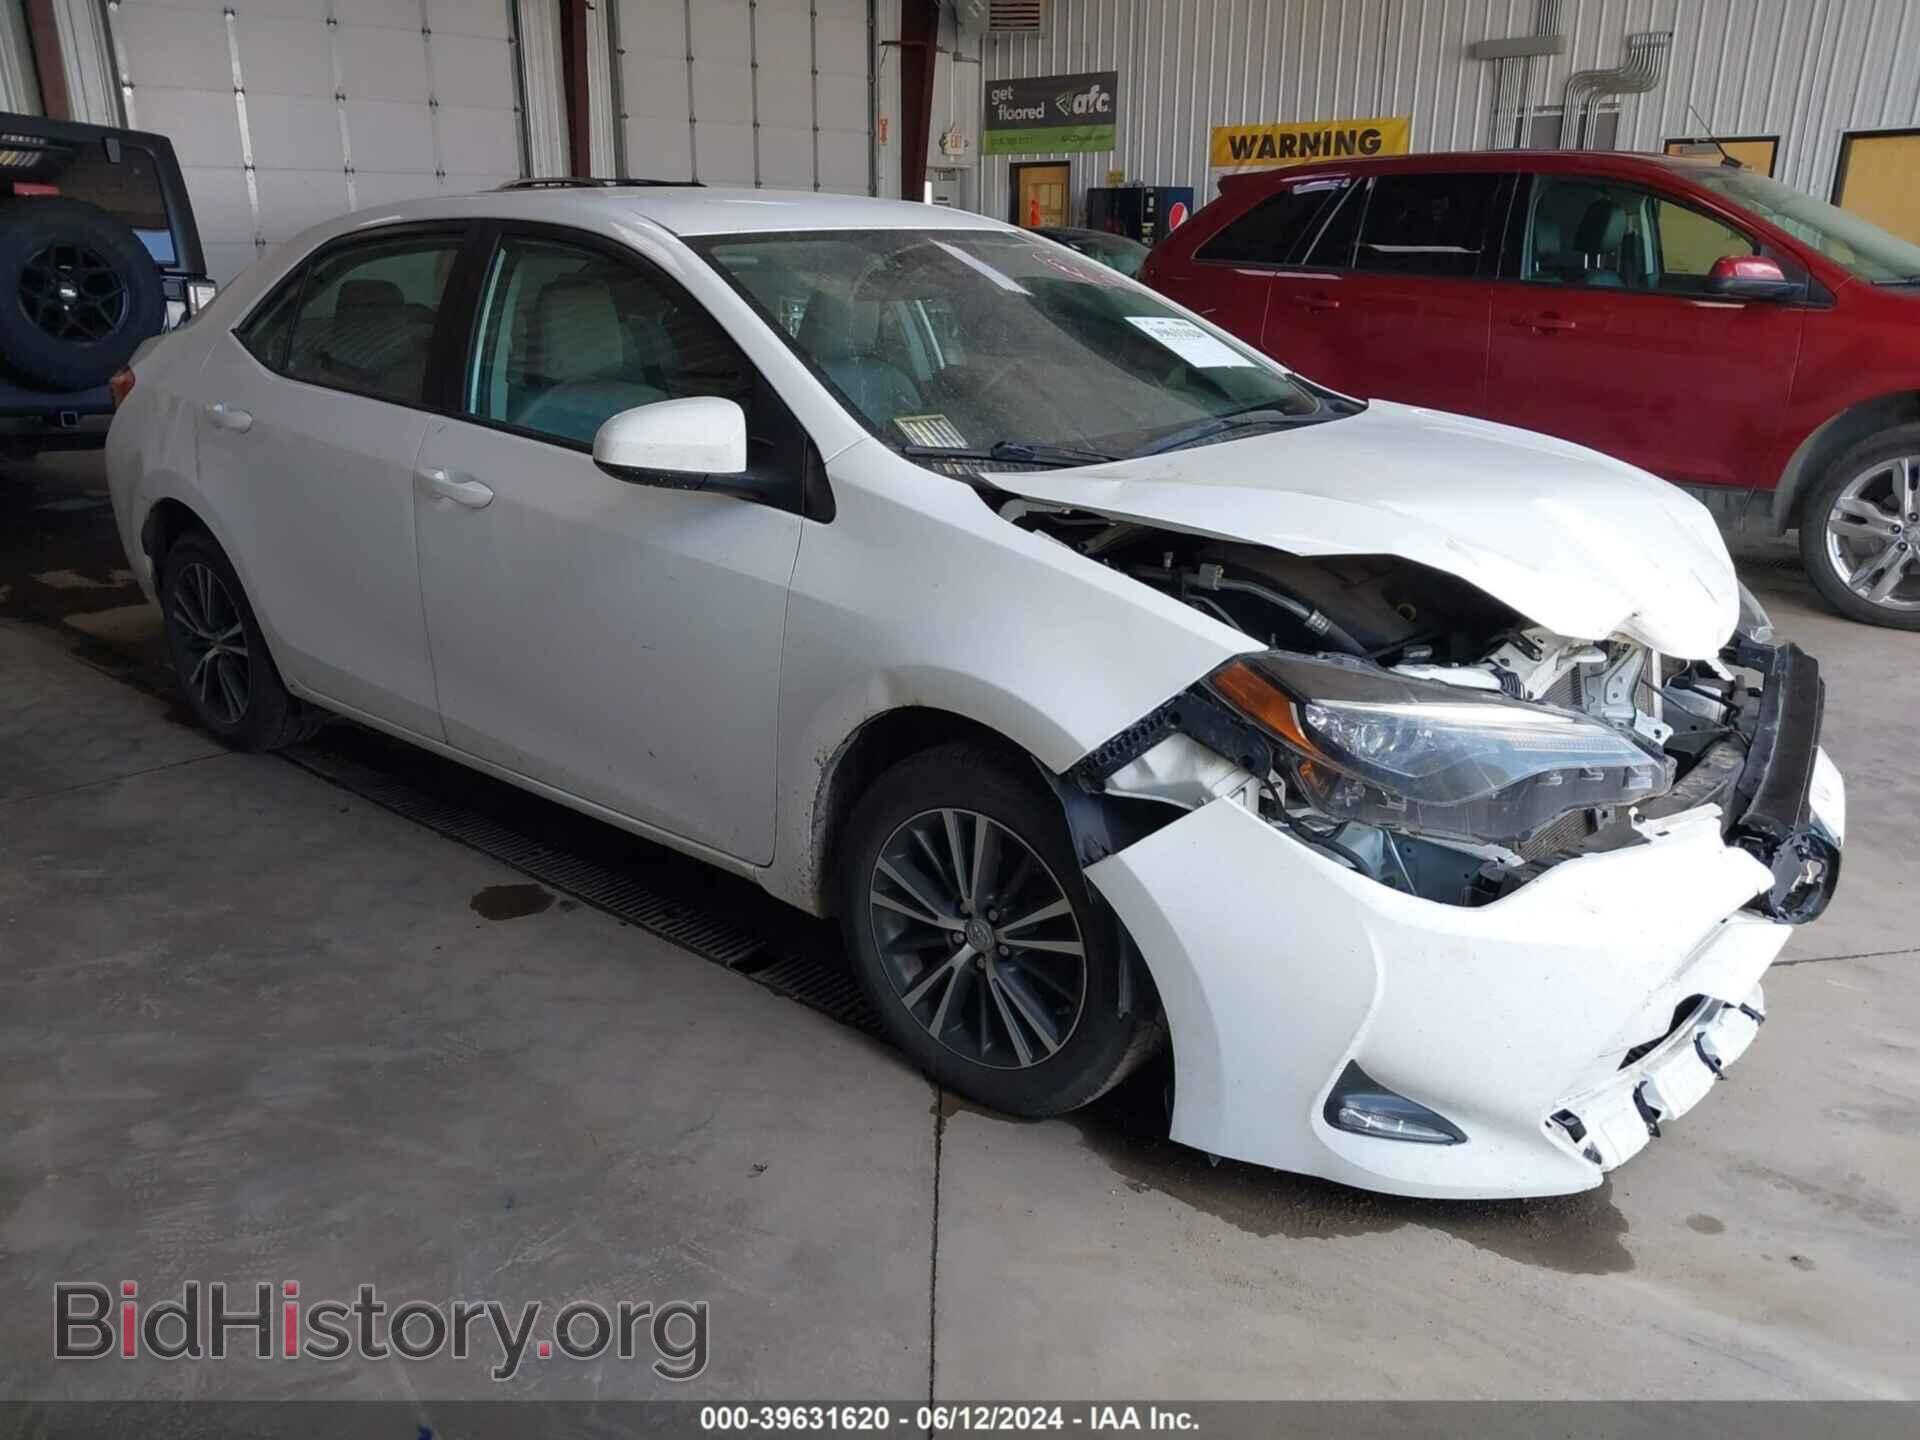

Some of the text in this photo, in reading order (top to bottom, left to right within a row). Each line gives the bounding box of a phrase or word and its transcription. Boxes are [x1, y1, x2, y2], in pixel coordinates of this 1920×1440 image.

[991, 85, 1014, 106] get
[1072, 84, 1111, 115] afc
[998, 101, 1045, 120] floored
[1228, 128, 1382, 160] WARNING
